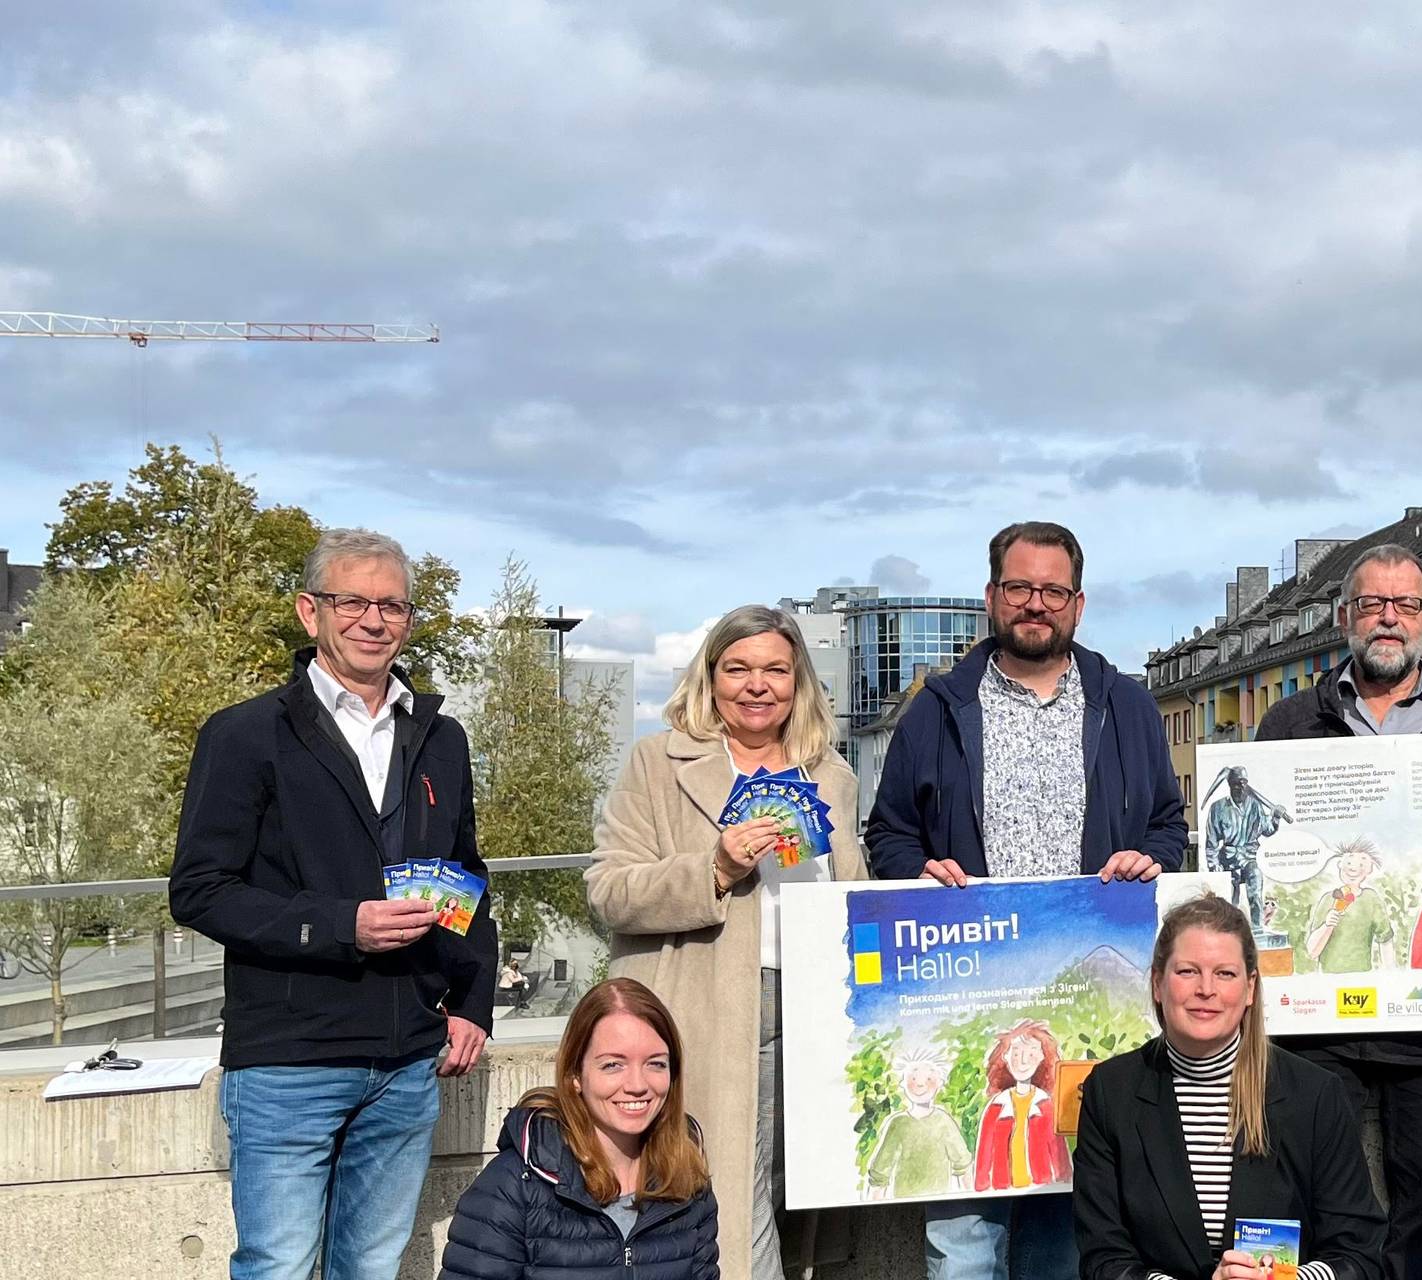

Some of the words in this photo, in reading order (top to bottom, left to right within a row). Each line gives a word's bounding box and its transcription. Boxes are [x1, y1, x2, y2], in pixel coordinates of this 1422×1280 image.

[895, 913, 1018, 952] Привіт!
[896, 950, 980, 982] Hallo!
[899, 992, 959, 1006] Приходьте
[1058, 981, 1089, 993] Зіген!
[900, 1006, 931, 1016] Komm
[933, 1004, 949, 1014] mit
[952, 1003, 970, 1012] und
[1388, 1002, 1403, 1013] Be
